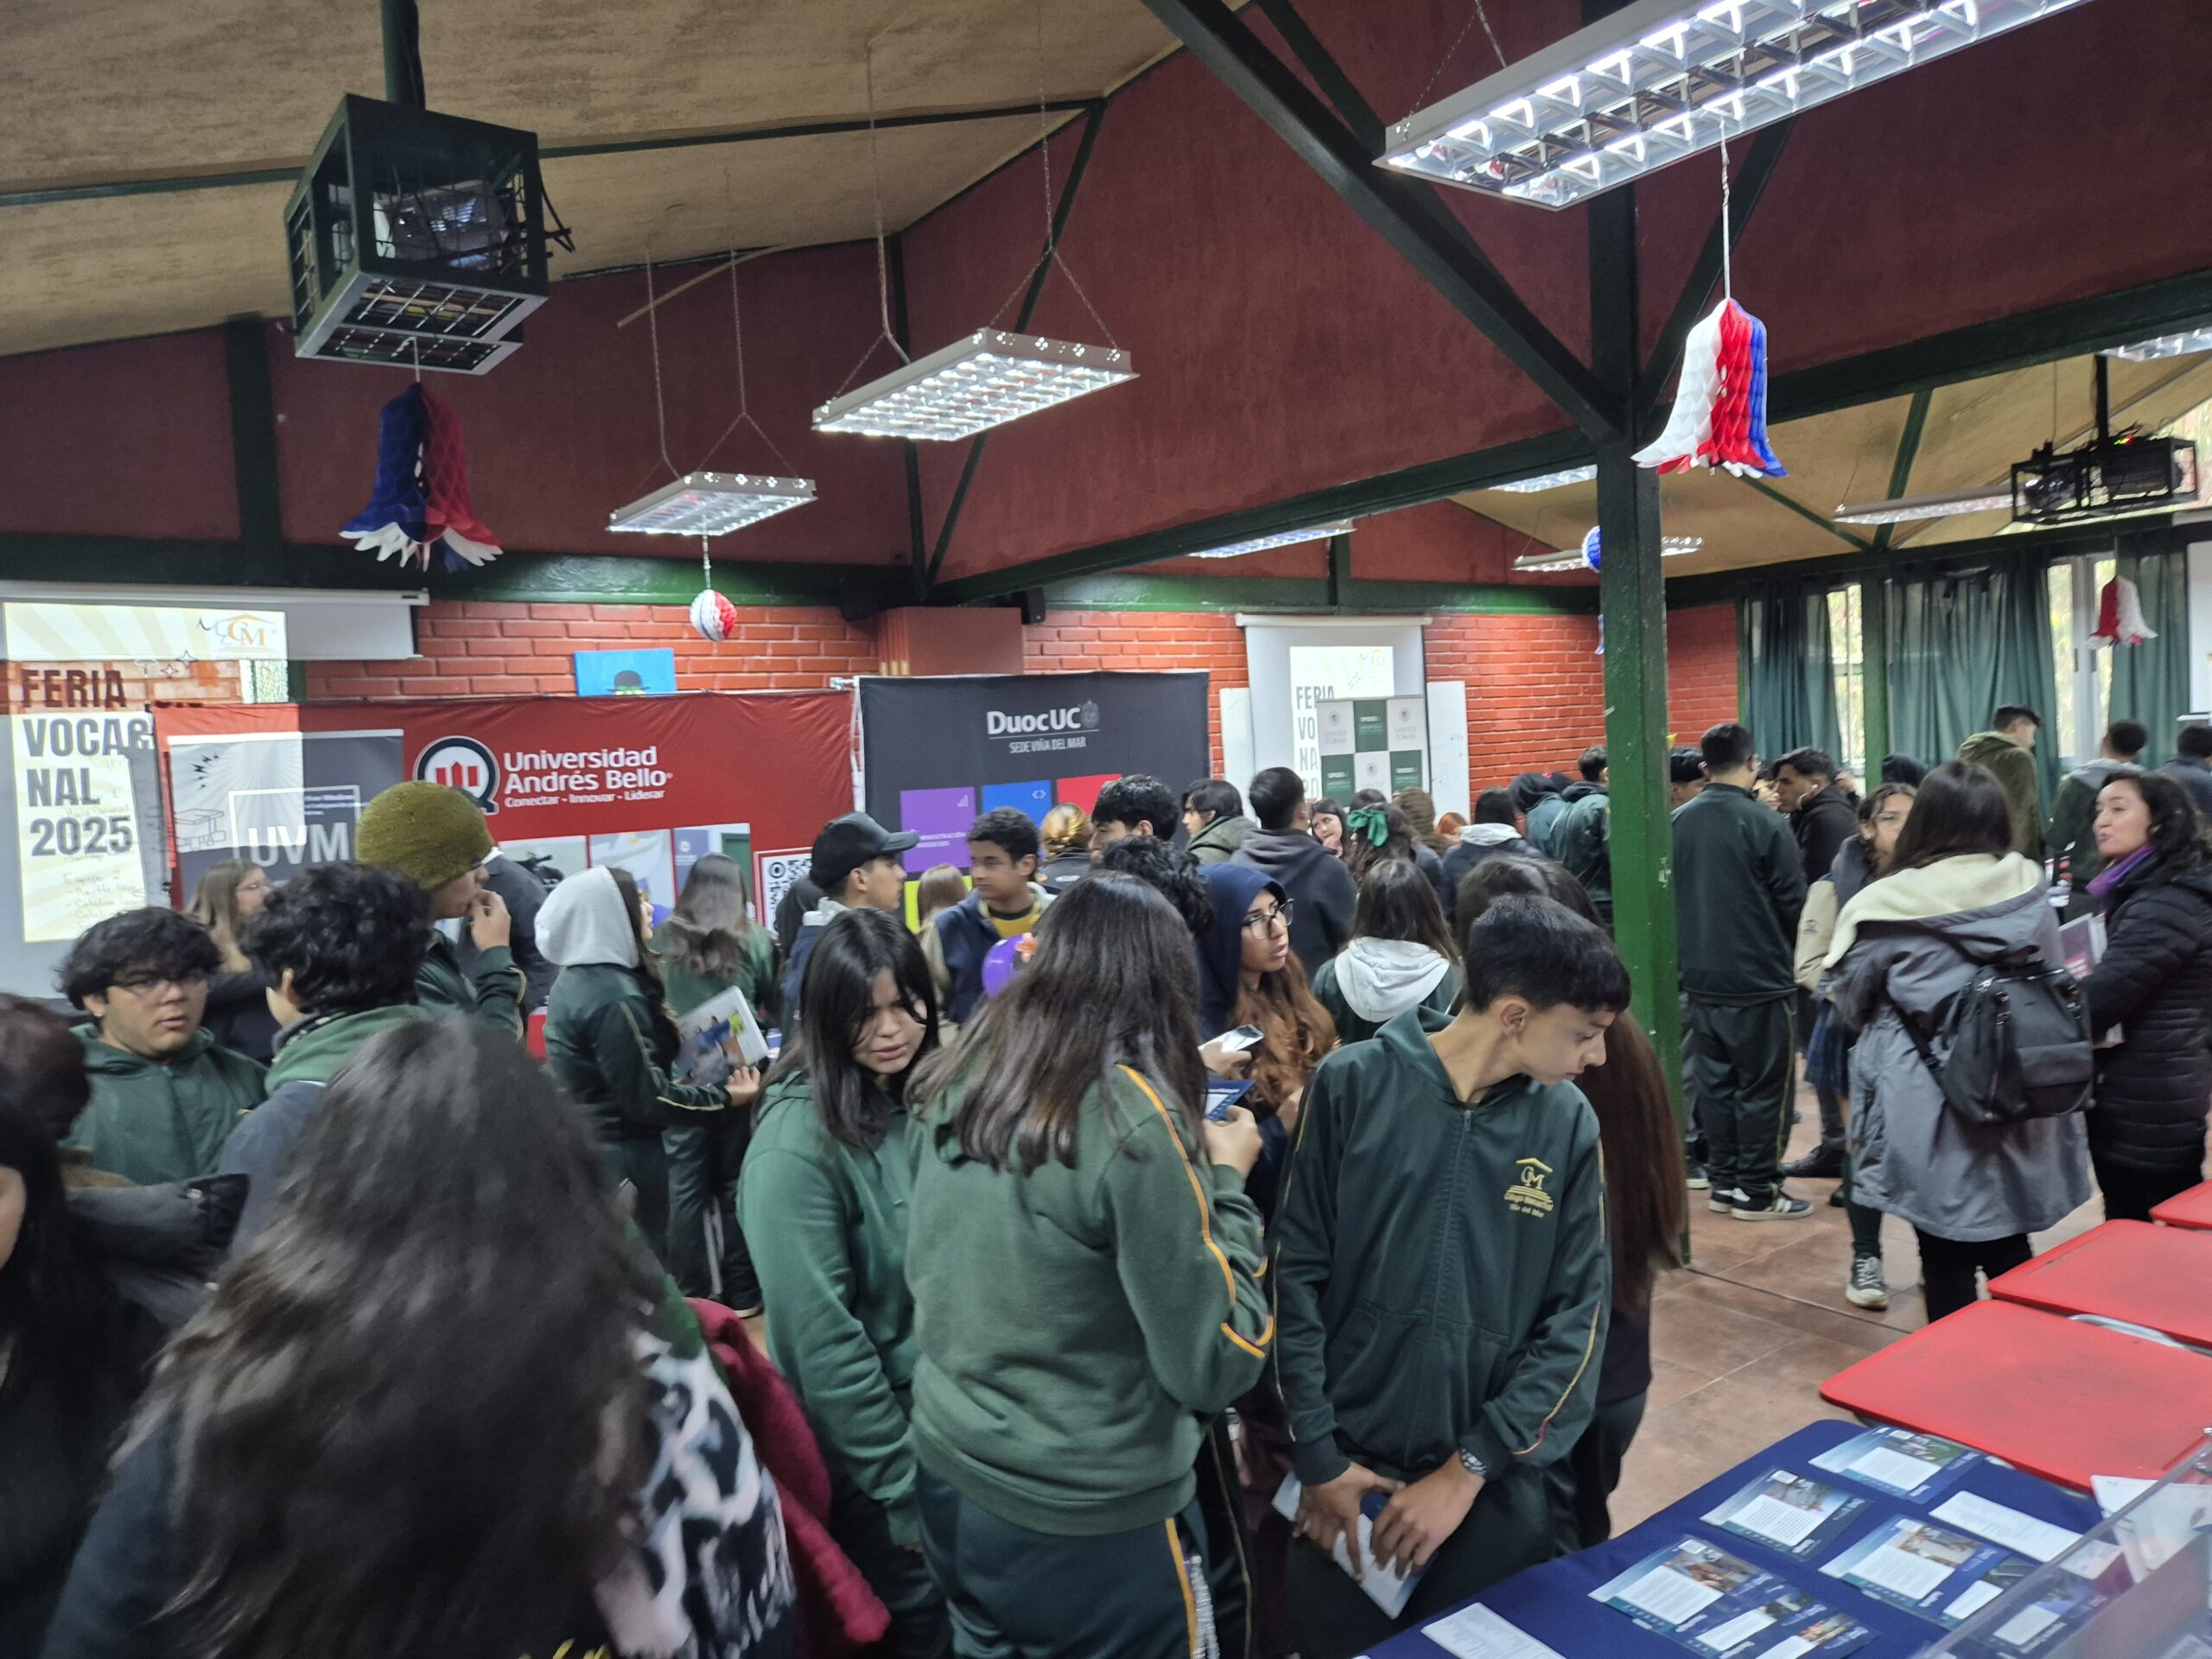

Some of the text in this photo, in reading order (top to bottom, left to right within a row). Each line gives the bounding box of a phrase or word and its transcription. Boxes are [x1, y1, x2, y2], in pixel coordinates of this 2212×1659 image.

[22, 669, 127, 708] FERIA
[1009, 736, 1087, 753] SEDE VIÑA DEL MAR
[1324, 729, 1348, 739] SANTO
[504, 746, 658, 772] Universidad
[27, 767, 101, 807] NAL
[504, 768, 667, 795] Andrés Bello
[29, 815, 134, 856] 2025
[248, 822, 350, 868] UVM
